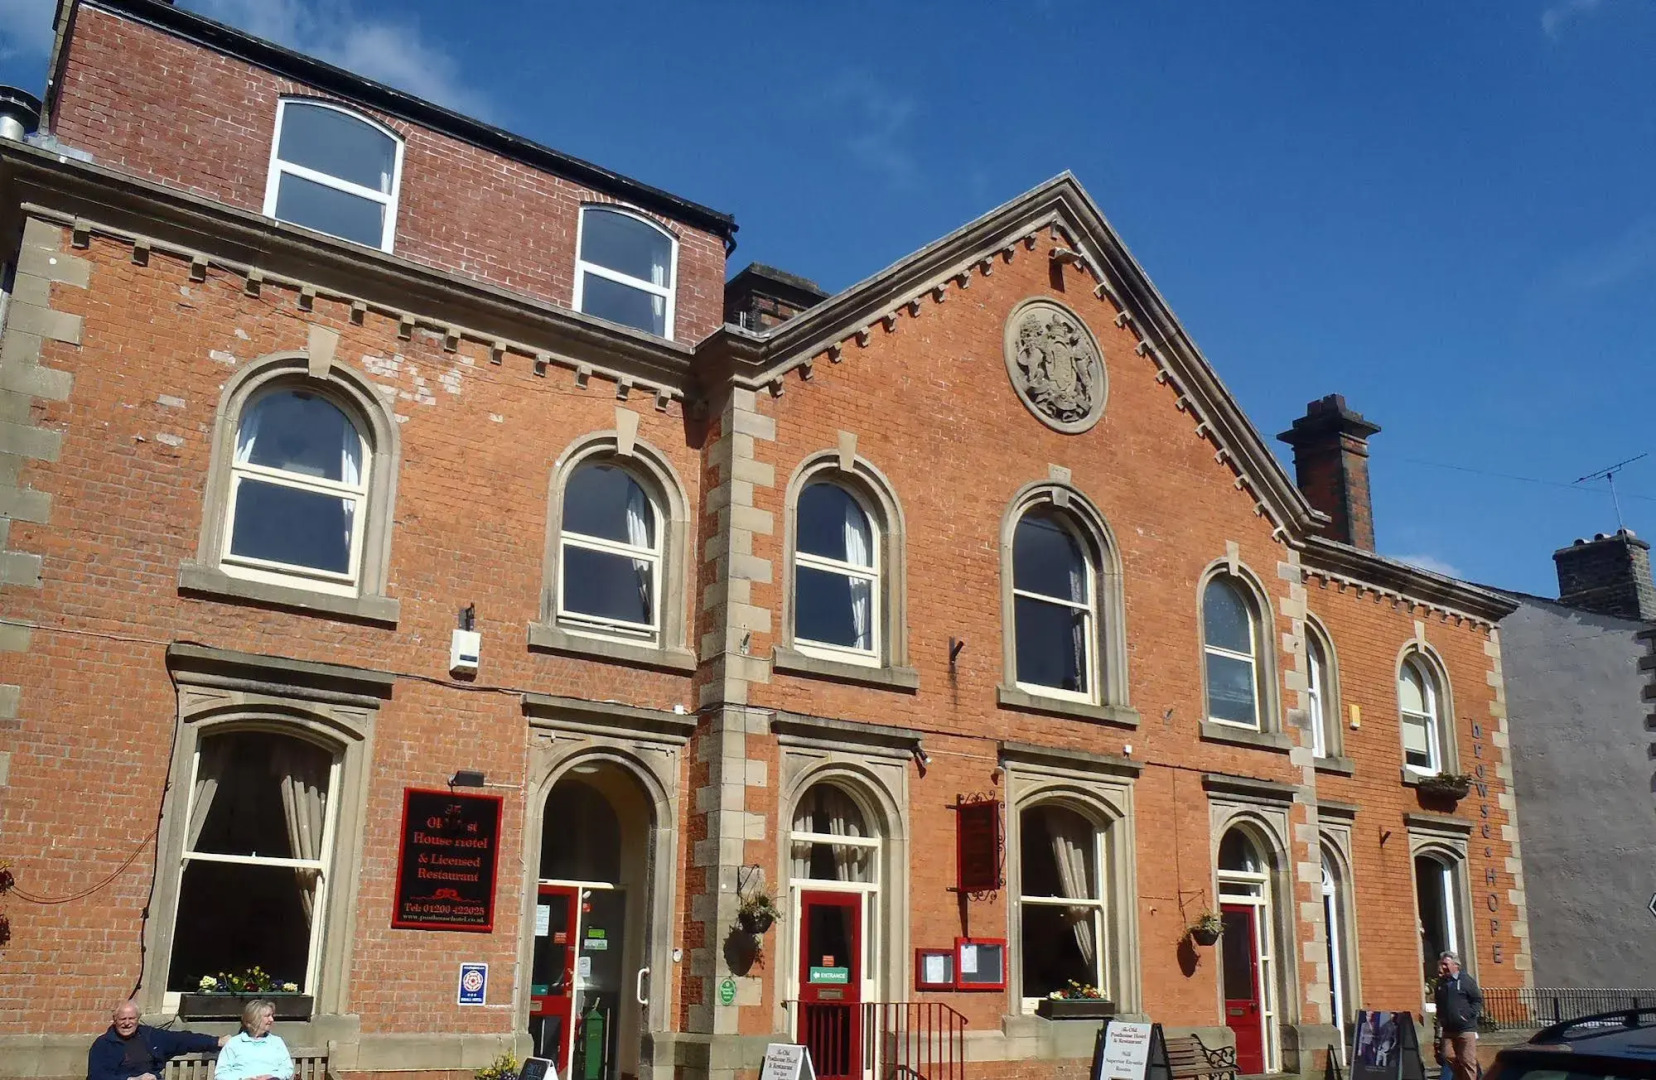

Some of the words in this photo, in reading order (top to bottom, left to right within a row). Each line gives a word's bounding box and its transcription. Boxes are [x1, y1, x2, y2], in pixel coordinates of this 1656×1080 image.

[413, 831, 452, 846] House
[418, 853, 428, 863] &
[431, 854, 481, 867] Licensed
[417, 868, 479, 882] Restaurant
[423, 904, 451, 914] 01200
[452, 906, 485, 915] 422025
